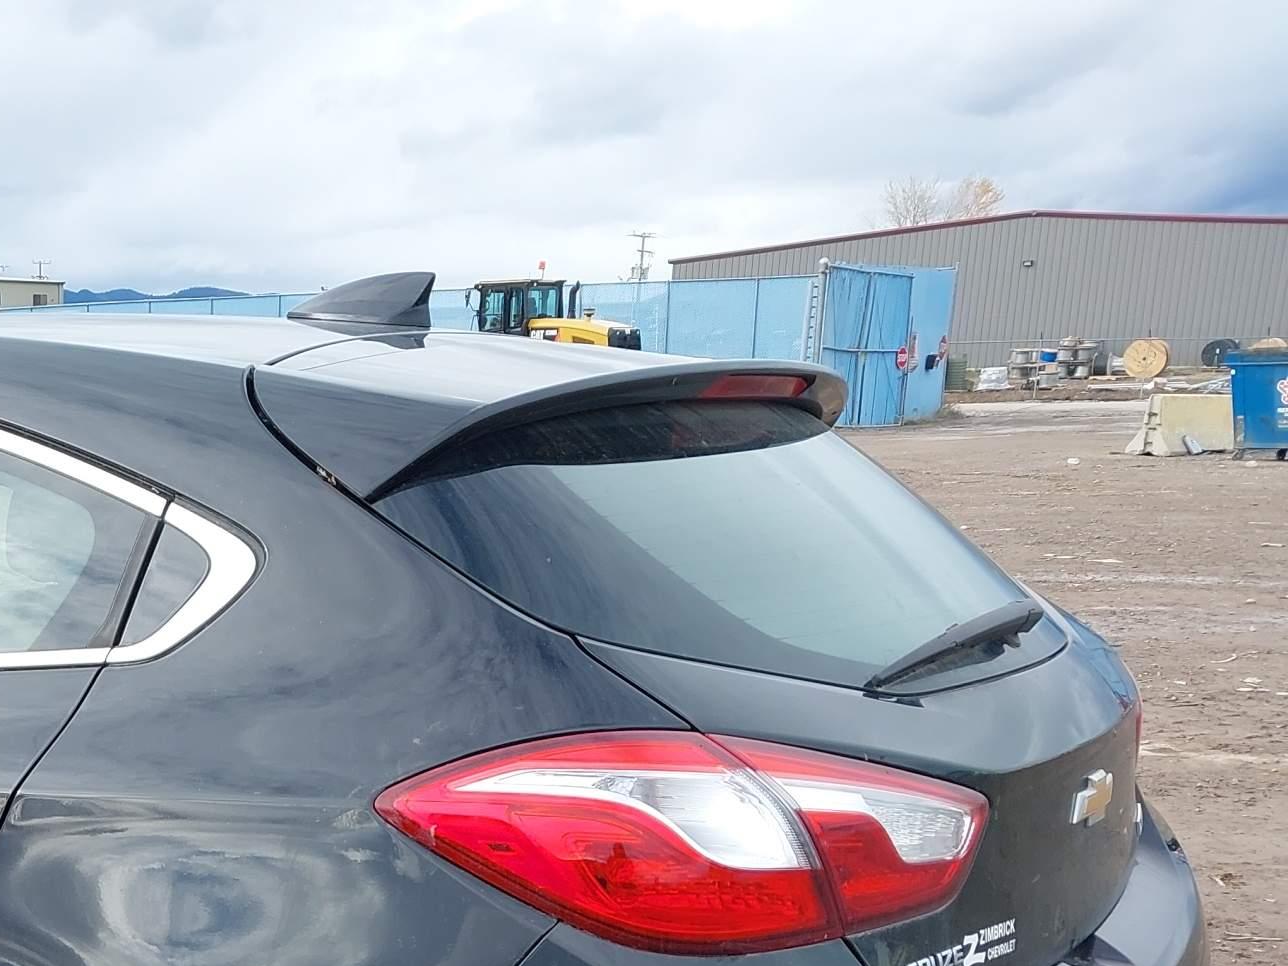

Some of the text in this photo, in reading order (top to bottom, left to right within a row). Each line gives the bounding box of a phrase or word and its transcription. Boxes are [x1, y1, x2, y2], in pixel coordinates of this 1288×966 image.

[530, 329, 545, 340] CAT
[979, 918, 1016, 945] ZIMBRICK
[987, 939, 1016, 960] CHEVROLET
